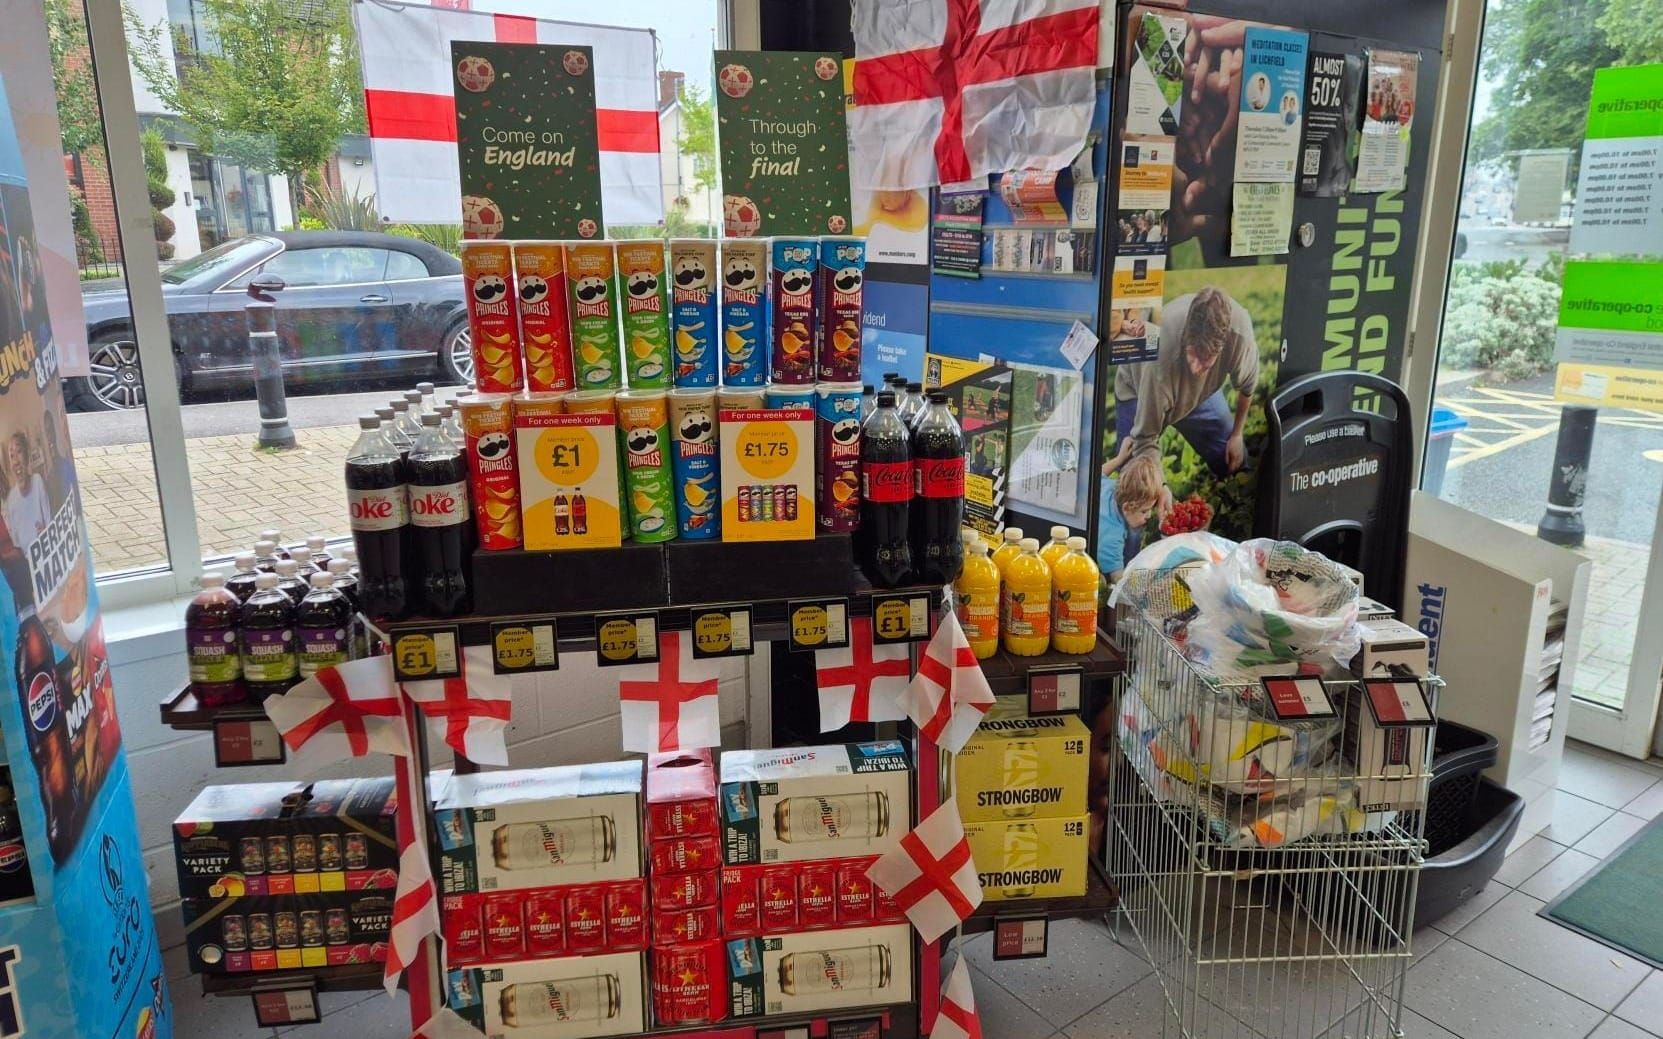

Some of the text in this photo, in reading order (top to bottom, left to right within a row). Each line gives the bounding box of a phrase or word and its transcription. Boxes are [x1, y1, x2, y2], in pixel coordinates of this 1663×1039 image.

[1259, 55, 1285, 66] LICHFIELD
[1313, 57, 1344, 76] ALMOST
[1311, 77, 1340, 107] 50%
[482, 127, 564, 144] Come on
[750, 118, 816, 139] Through
[750, 139, 797, 155] to the
[484, 146, 575, 168] England
[750, 156, 800, 178] final
[1366, 189, 1404, 292] FUN
[674, 287, 707, 304] PRINGLES
[724, 287, 756, 304] PRINGLES
[781, 293, 812, 308] PRINGLES
[475, 301, 508, 317] PRINGLES
[577, 302, 608, 318] PRINGLES
[628, 296, 660, 312] PRINGLES
[862, 312, 886, 328] vidend
[877, 344, 893, 354] Please
[584, 416, 601, 424] only
[1304, 432, 1326, 446] Please
[1327, 429, 1338, 439] use
[1339, 428, 1343, 436] a
[552, 444, 580, 467] £1
[680, 441, 714, 457] PRINGLES
[745, 443, 788, 456] £1.75
[479, 456, 512, 474] PRINGLES
[628, 451, 661, 467] PRINGLES
[1291, 457, 1378, 492] The co-operative
[352, 497, 392, 519] oke
[30, 488, 77, 570] PERFECT
[34, 522, 80, 603] MATCH
[795, 627, 826, 636] £1.75
[881, 617, 906, 632] £1
[603, 641, 636, 650] £1.75
[698, 634, 730, 643] £1.75
[194, 646, 225, 656] SQUASH
[251, 644, 284, 655] SQUASH
[306, 644, 337, 653] SQUASH
[499, 649, 533, 659] £1.75
[402, 651, 432, 669] £1
[30, 688, 54, 716] PEPSI
[65, 682, 93, 740] MAX
[979, 718, 1065, 731] RONGBOW
[1064, 741, 1076, 750] 12
[977, 788, 1062, 806] STRONGBOW
[727, 827, 737, 842] TRIP
[1064, 823, 1075, 832] 12
[738, 833, 748, 853] IBIZA!
[183, 857, 230, 866] VARIETY
[728, 850, 738, 863] WIN
[193, 866, 222, 874] PACK
[723, 875, 741, 883] PACK
[978, 869, 1062, 887] STRONGBOW
[765, 899, 793, 908] ESTRELLA
[803, 896, 832, 904] ESTRELLA
[841, 893, 869, 901] ESTRELLA
[444, 902, 463, 910] PACK
[530, 922, 561, 931] ESTRELLA
[571, 919, 600, 928] ESTRELLA
[611, 915, 641, 924] ESTRELLA
[489, 926, 520, 934] ESTRELLA
